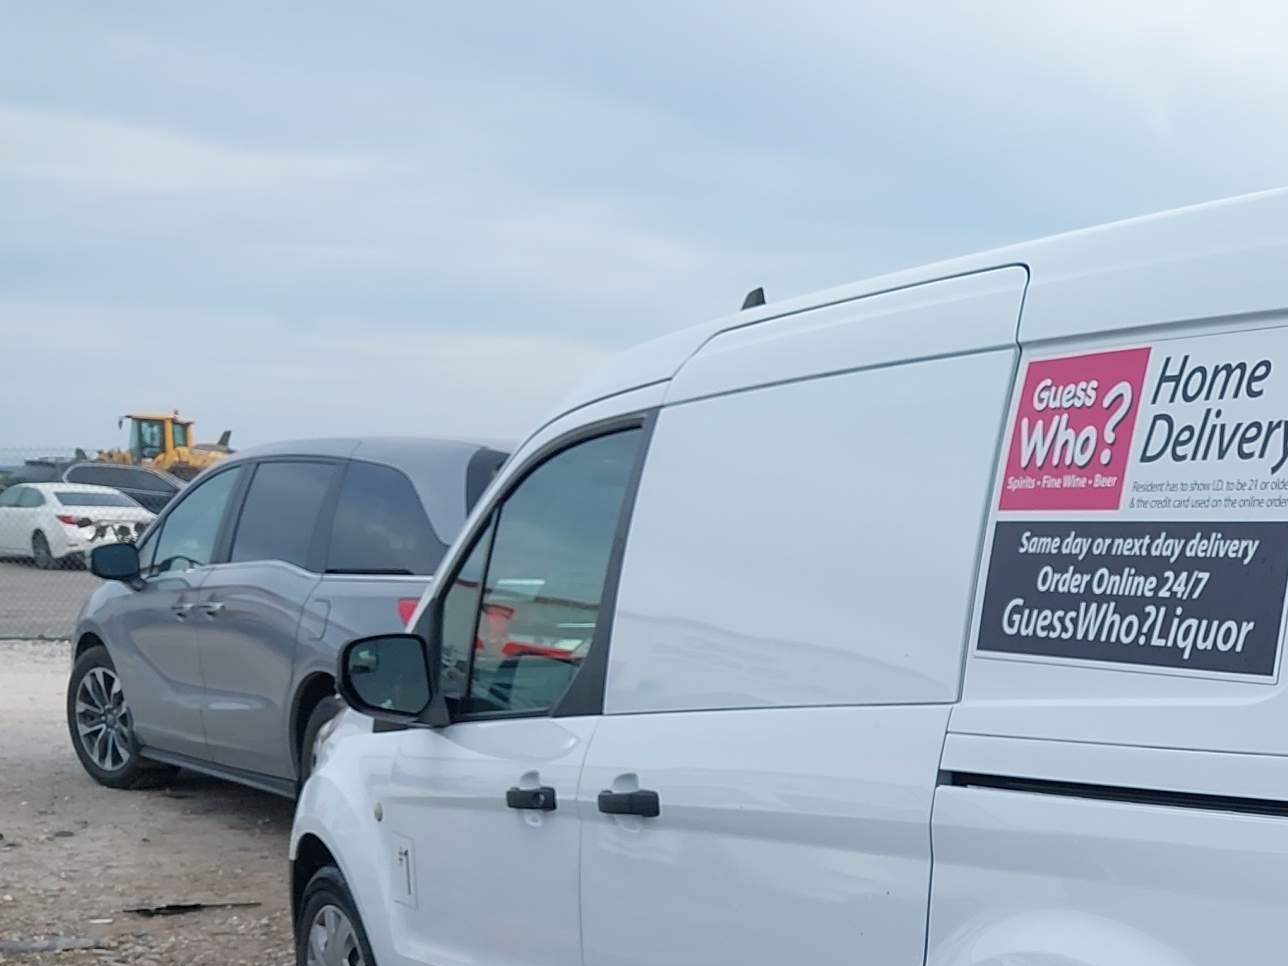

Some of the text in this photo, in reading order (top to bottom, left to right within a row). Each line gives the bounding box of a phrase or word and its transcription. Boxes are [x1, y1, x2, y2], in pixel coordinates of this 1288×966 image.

[1032, 378, 1099, 413] Guess
[1151, 354, 1272, 405] Home
[1019, 381, 1133, 470] Who?
[1007, 473, 1118, 492] Spirits Fine Wine Beer
[1132, 480, 1165, 493] Resident
[1166, 480, 1180, 493] has
[1180, 481, 1189, 492] to
[1190, 480, 1210, 492] show
[1226, 480, 1236, 491] to
[1237, 479, 1248, 491] be
[1248, 479, 1258, 491] 21
[1260, 480, 1269, 490] or
[1129, 497, 1135, 509] &
[1136, 497, 1150, 508] the
[1150, 497, 1172, 508] credit
[1172, 496, 1190, 508] card
[1191, 496, 1210, 508] used
[1211, 498, 1222, 508] on
[1223, 496, 1238, 508] the
[1238, 495, 1264, 508] online
[1019, 531, 1260, 565] Same day or next day delivery
[1036, 565, 1211, 600] Order Online 24/7
[1002, 597, 1255, 660] GuessWho?Liquor
